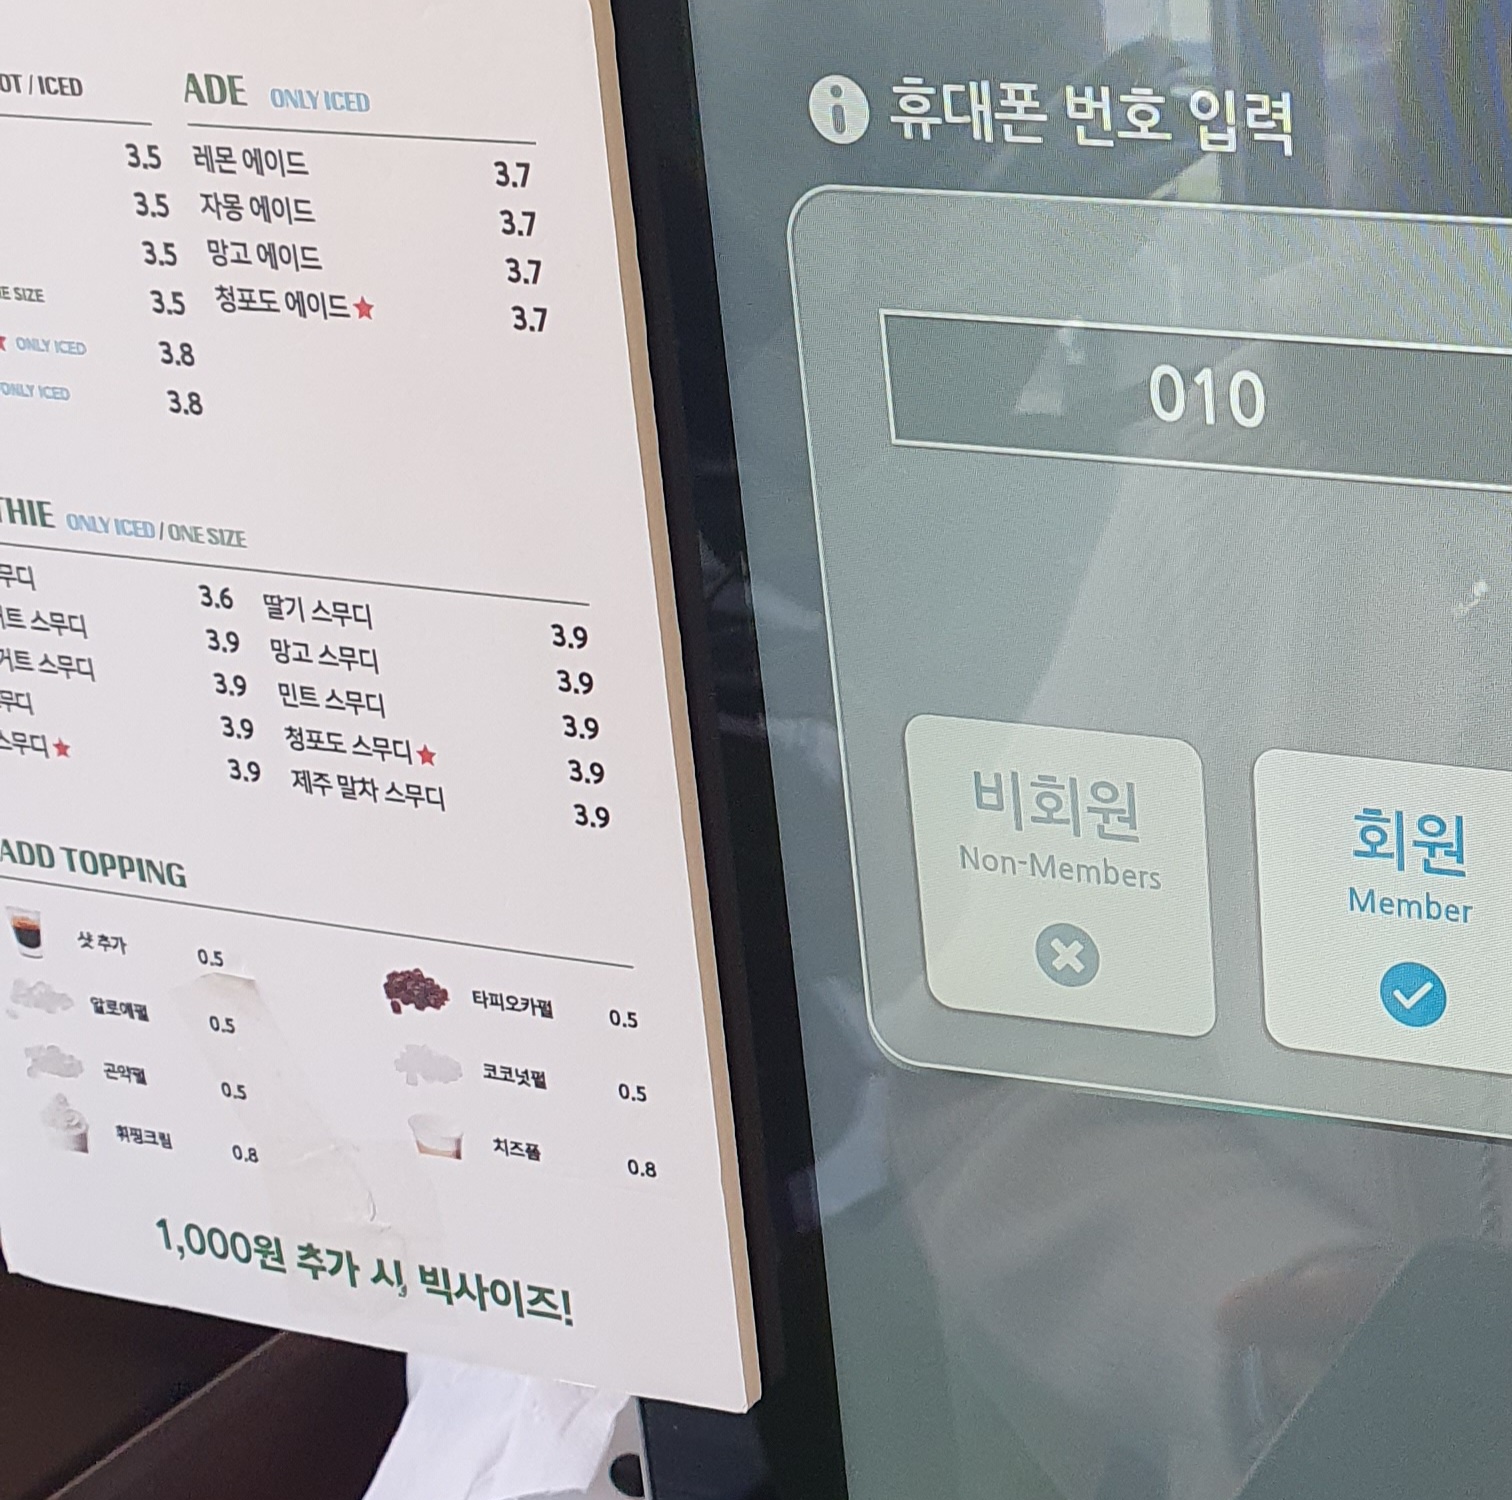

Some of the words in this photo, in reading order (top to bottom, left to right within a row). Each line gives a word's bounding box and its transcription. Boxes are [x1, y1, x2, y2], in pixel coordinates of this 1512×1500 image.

[38, 76, 83, 96] ICED
[184, 73, 248, 107] ADE
[270, 87, 320, 111] ONLY
[323, 91, 371, 113] ICED
[890, 77, 1048, 146] 휴대폰
[1065, 84, 1172, 149] 번호
[1190, 88, 1295, 156] 입력
[125, 143, 162, 169] 3.5
[193, 145, 237, 175] 레몬
[242, 147, 309, 178] 에이드
[494, 161, 531, 188] 3.7
[133, 192, 170, 218] 3.5
[201, 192, 243, 222] 자몽
[249, 195, 316, 226] 에이드
[499, 210, 536, 237] 3.7
[141, 240, 178, 266] 3.5
[207, 238, 252, 269] 망고
[256, 242, 322, 273] 에이드
[505, 258, 542, 285] 3.7
[0, 285, 11, 300] E
[14, 287, 46, 303] SIZE
[150, 290, 186, 316] 3.5
[215, 285, 281, 315] 청포도
[284, 289, 351, 320] 에이드
[512, 306, 548, 333] 3.7
[15, 337, 50, 353] ONLY
[54, 340, 87, 355] ICED
[158, 341, 196, 367] 3.8
[0, 382, 35, 398] ONLY
[38, 384, 70, 401] ICED
[166, 390, 204, 415] 3.8
[1149, 363, 1267, 428] 010
[66, 513, 111, 535] ONLY
[114, 518, 155, 539] ICED
[168, 523, 205, 544] ONE
[208, 528, 248, 548] SIZE
[198, 584, 234, 609] 3.6
[30, 610, 88, 639] 스무디
[206, 629, 239, 653] 3.9
[263, 594, 305, 623] 딸기
[312, 599, 373, 630] 스무디
[551, 624, 588, 651] 3.9
[38, 653, 95, 682] 스무디
[213, 672, 247, 696] 3.9
[270, 638, 313, 665] 망고
[318, 644, 380, 675] 스무디
[556, 669, 594, 696] 3.9
[220, 715, 254, 739] 3.9
[278, 682, 320, 709] 민트
[325, 687, 386, 718] 스무디
[563, 714, 600, 741] 3.9
[227, 758, 261, 782] 3.9
[285, 725, 347, 756] 청포도
[352, 735, 413, 765] 스무디
[568, 759, 605, 786] 3.9
[291, 768, 334, 800] 제주
[338, 773, 379, 804] 말차
[385, 780, 446, 811] 스무디
[574, 803, 611, 830] 3.9
[973, 769, 1141, 844] 비회원
[1353, 807, 1467, 878] 회원
[0, 838, 56, 870] ADD
[60, 845, 188, 889] TOPPING
[960, 844, 1163, 891] Non-Members
[1348, 886, 1473, 925] Member
[77, 930, 94, 949] 샷
[97, 934, 127, 955] 추가
[197, 948, 224, 967] 0.5
[90, 996, 150, 1022] 알로에펄
[209, 1016, 236, 1034] 0.5
[471, 989, 554, 1019] 타피오카펄
[608, 1009, 638, 1029] 0.5
[103, 1062, 148, 1086] 곤약펄
[220, 1082, 247, 1101] 0.5
[483, 1062, 548, 1090] 코코넛펄
[618, 1083, 648, 1102] 0.5
[115, 1124, 173, 1150] 휘핑크림
[231, 1145, 259, 1164] 0.8
[492, 1136, 541, 1162] 치즈폼
[627, 1158, 658, 1179] 0.8
[155, 1217, 288, 1274] 1,000원
[297, 1242, 360, 1288] 추가
[418, 1264, 574, 1327] 빅사이즈!
